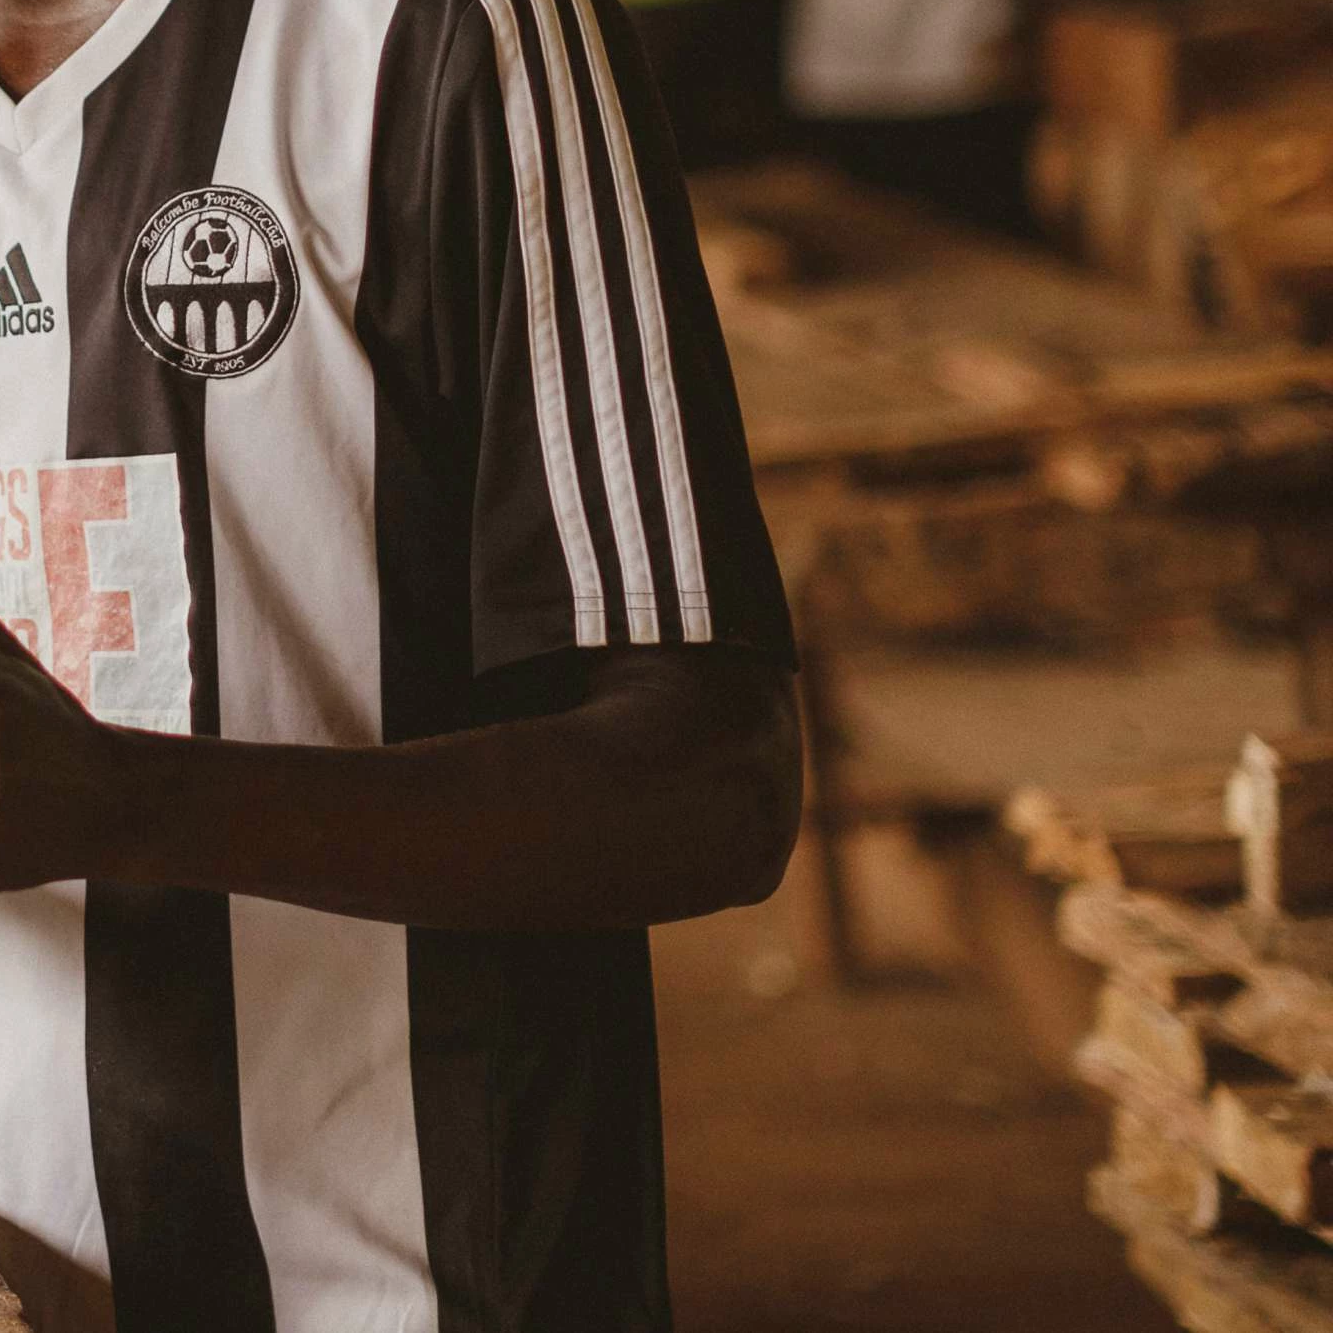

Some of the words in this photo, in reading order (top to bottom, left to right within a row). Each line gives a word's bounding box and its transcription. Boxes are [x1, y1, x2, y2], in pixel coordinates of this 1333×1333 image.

[141, 198, 199, 251] Balcombe
[203, 192, 264, 222] Football
[260, 217, 286, 249] Club
